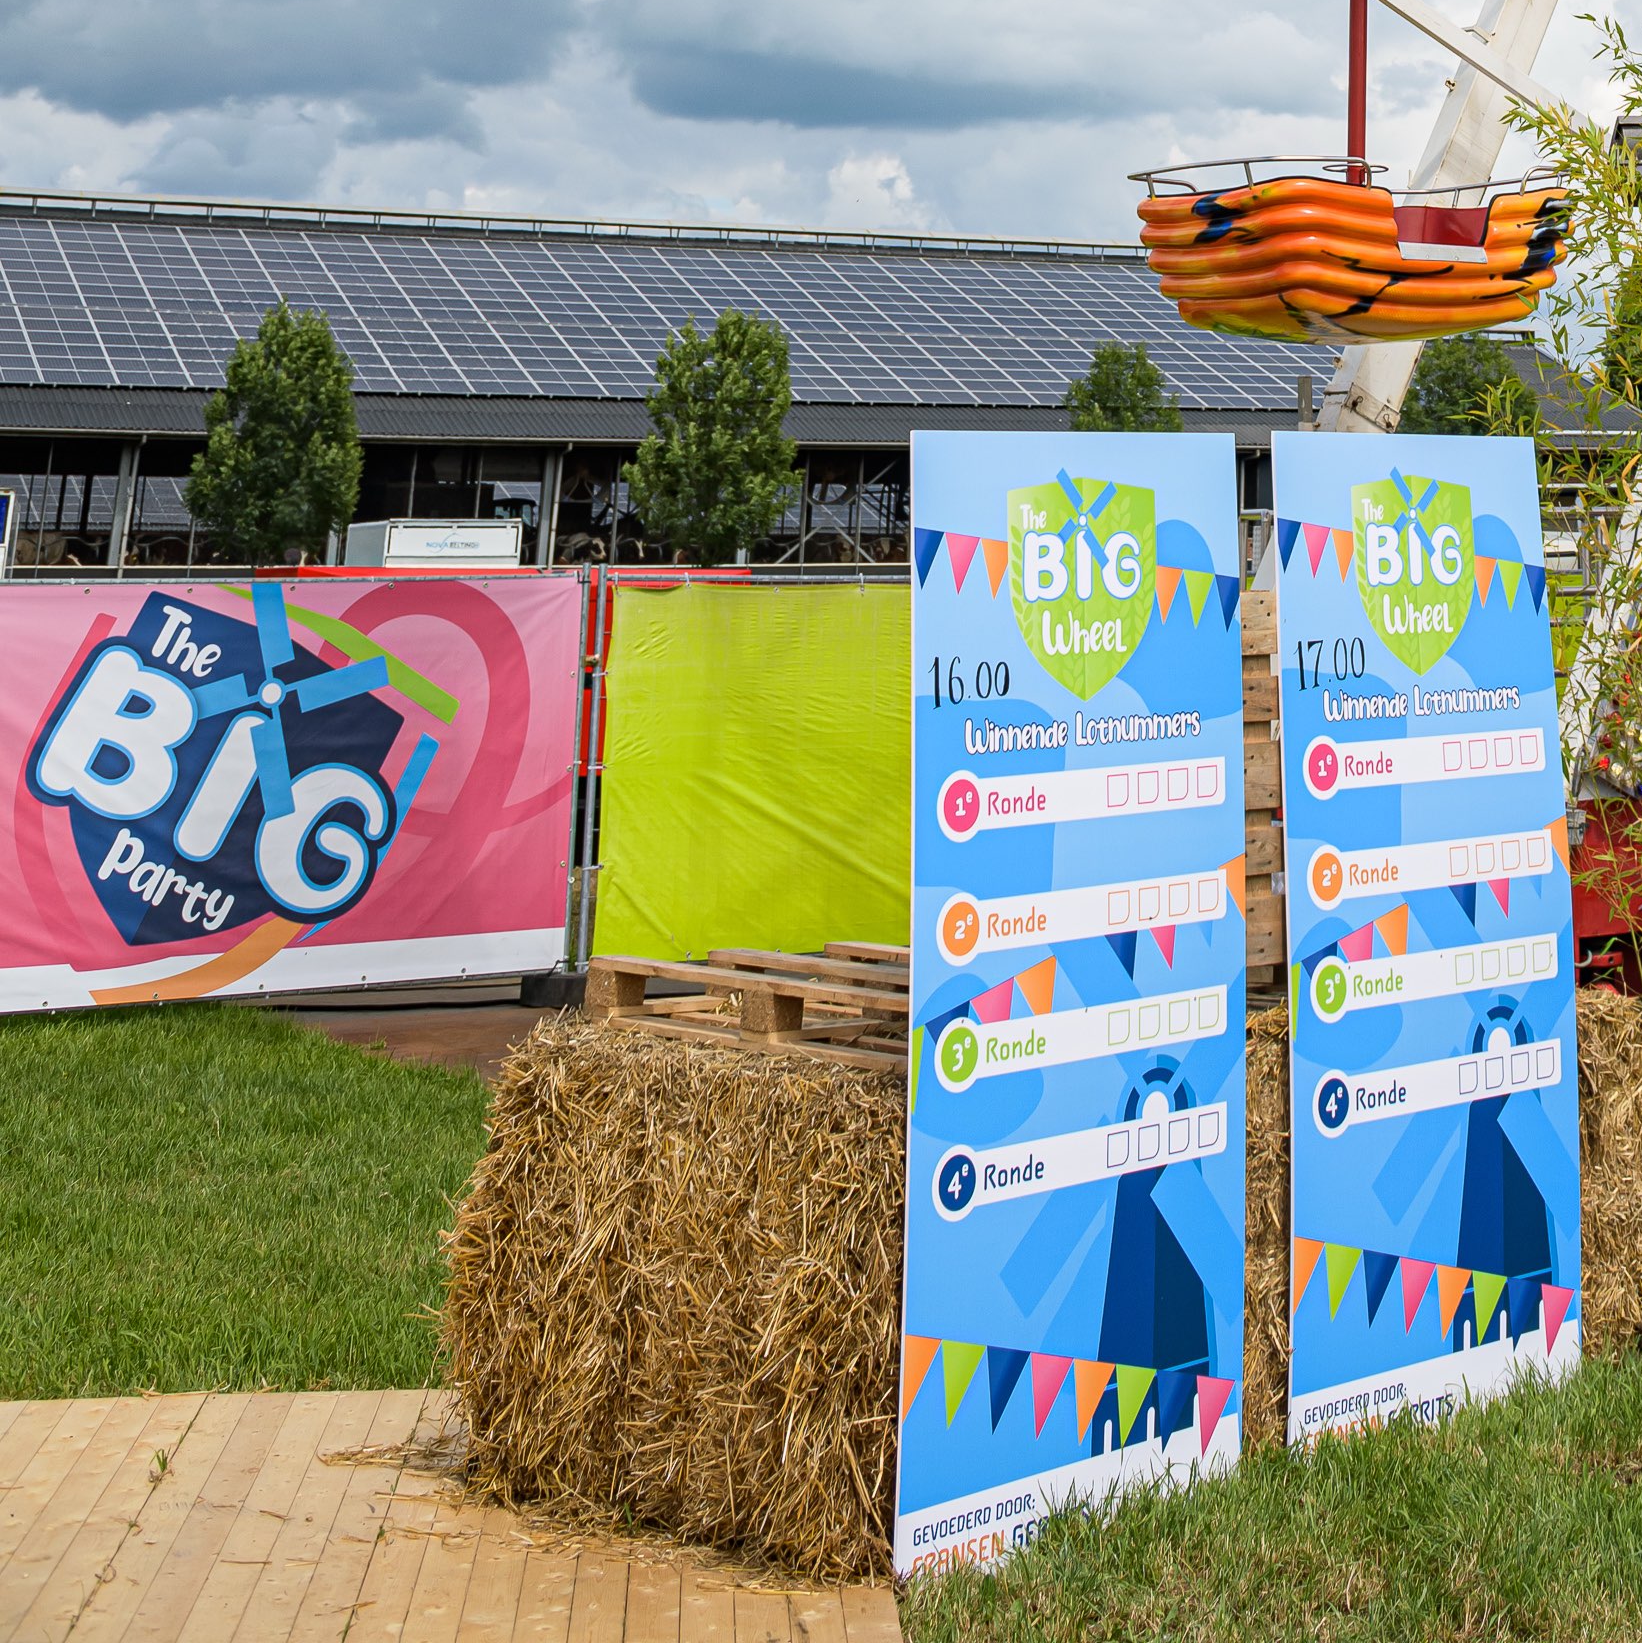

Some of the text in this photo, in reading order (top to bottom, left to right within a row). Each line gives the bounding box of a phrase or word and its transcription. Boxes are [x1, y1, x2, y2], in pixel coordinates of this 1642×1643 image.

[1020, 504, 1046, 529] The
[1361, 498, 1384, 521] The
[149, 604, 222, 679] The
[1293, 637, 1365, 691] 17.00
[928, 656, 1010, 709] 16.00
[1323, 684, 1520, 722] Winnende Lotnummers
[965, 710, 1200, 755] Winnende Lotnummers
[1344, 752, 1393, 776] Ronde
[988, 789, 1047, 815] Ronde
[1349, 858, 1399, 885] Ronde
[987, 908, 1047, 937] Ronde
[1352, 969, 1403, 996] Ronde
[986, 1033, 1047, 1063] Ronde
[1355, 1083, 1407, 1111] Ronde
[984, 1155, 1045, 1192] Ronde
[1304, 1383, 1407, 1424] GEVOEDERD DOOR:
[913, 1506, 991, 1546] GEVOEDERD
[996, 1493, 1036, 1521] DOOR:
